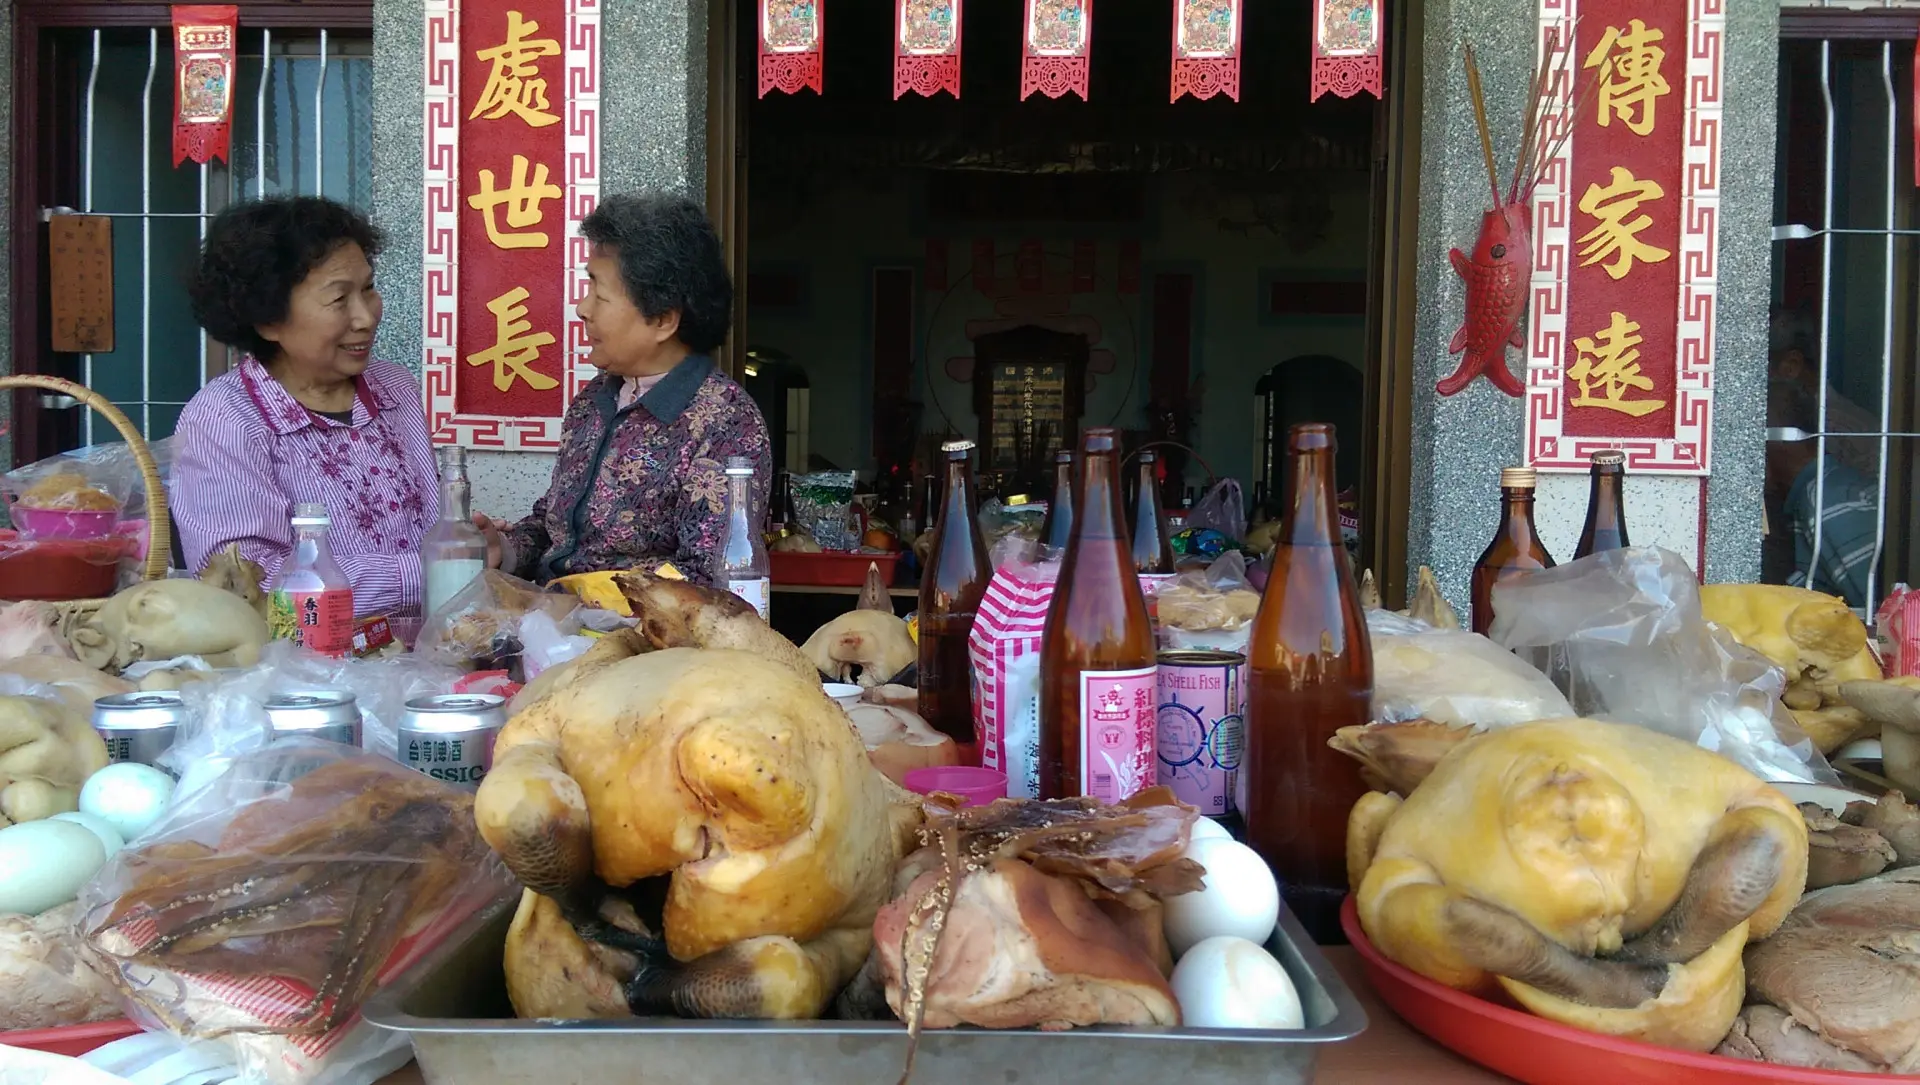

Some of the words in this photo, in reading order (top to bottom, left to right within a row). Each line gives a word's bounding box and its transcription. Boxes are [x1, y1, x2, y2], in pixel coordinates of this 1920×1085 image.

[467, 10, 562, 392] 處世長
[1567, 18, 1672, 417] 傳家遠
[1167, 672, 1197, 690] SHELL
[1199, 674, 1221, 690] FISH
